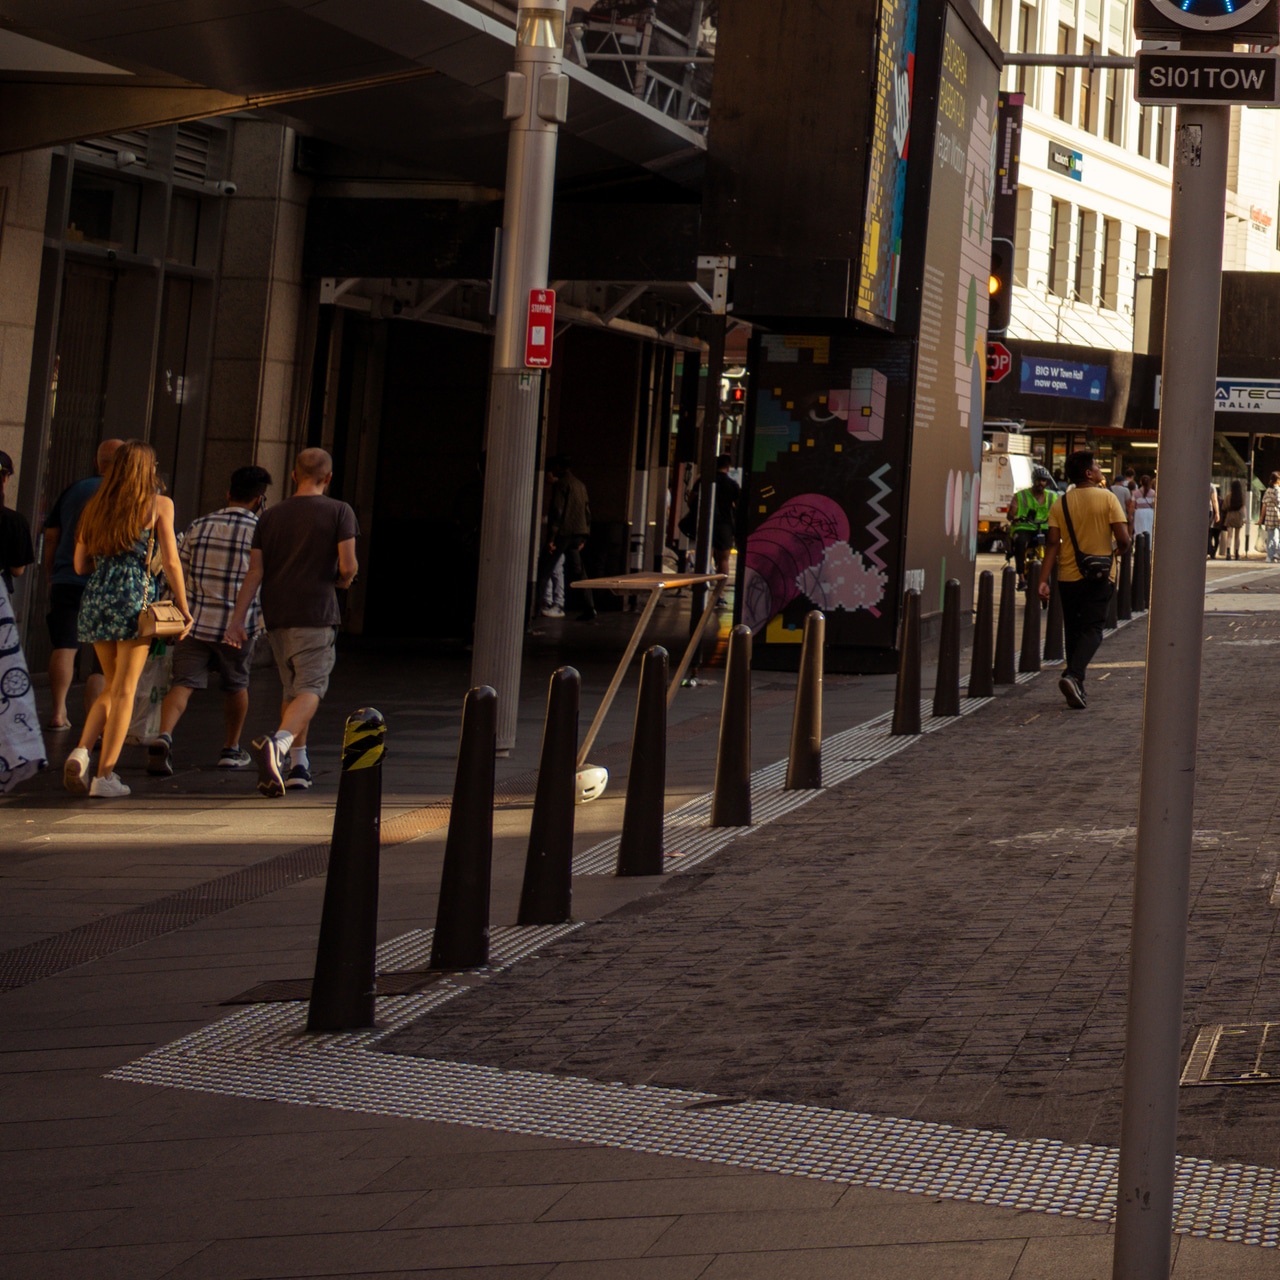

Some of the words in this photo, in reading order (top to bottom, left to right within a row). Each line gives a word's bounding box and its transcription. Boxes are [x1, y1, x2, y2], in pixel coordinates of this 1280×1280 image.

[538, 293, 547, 303] NO
[531, 303, 552, 314] STOPPING
[988, 355, 1009, 370] OP
[1035, 365, 1049, 377] BIG
[1050, 366, 1059, 377] W
[1060, 368, 1073, 379] Town
[1073, 369, 1084, 380] Hall
[1034, 378, 1050, 388] now
[1217, 402, 1262, 410] RALIA
